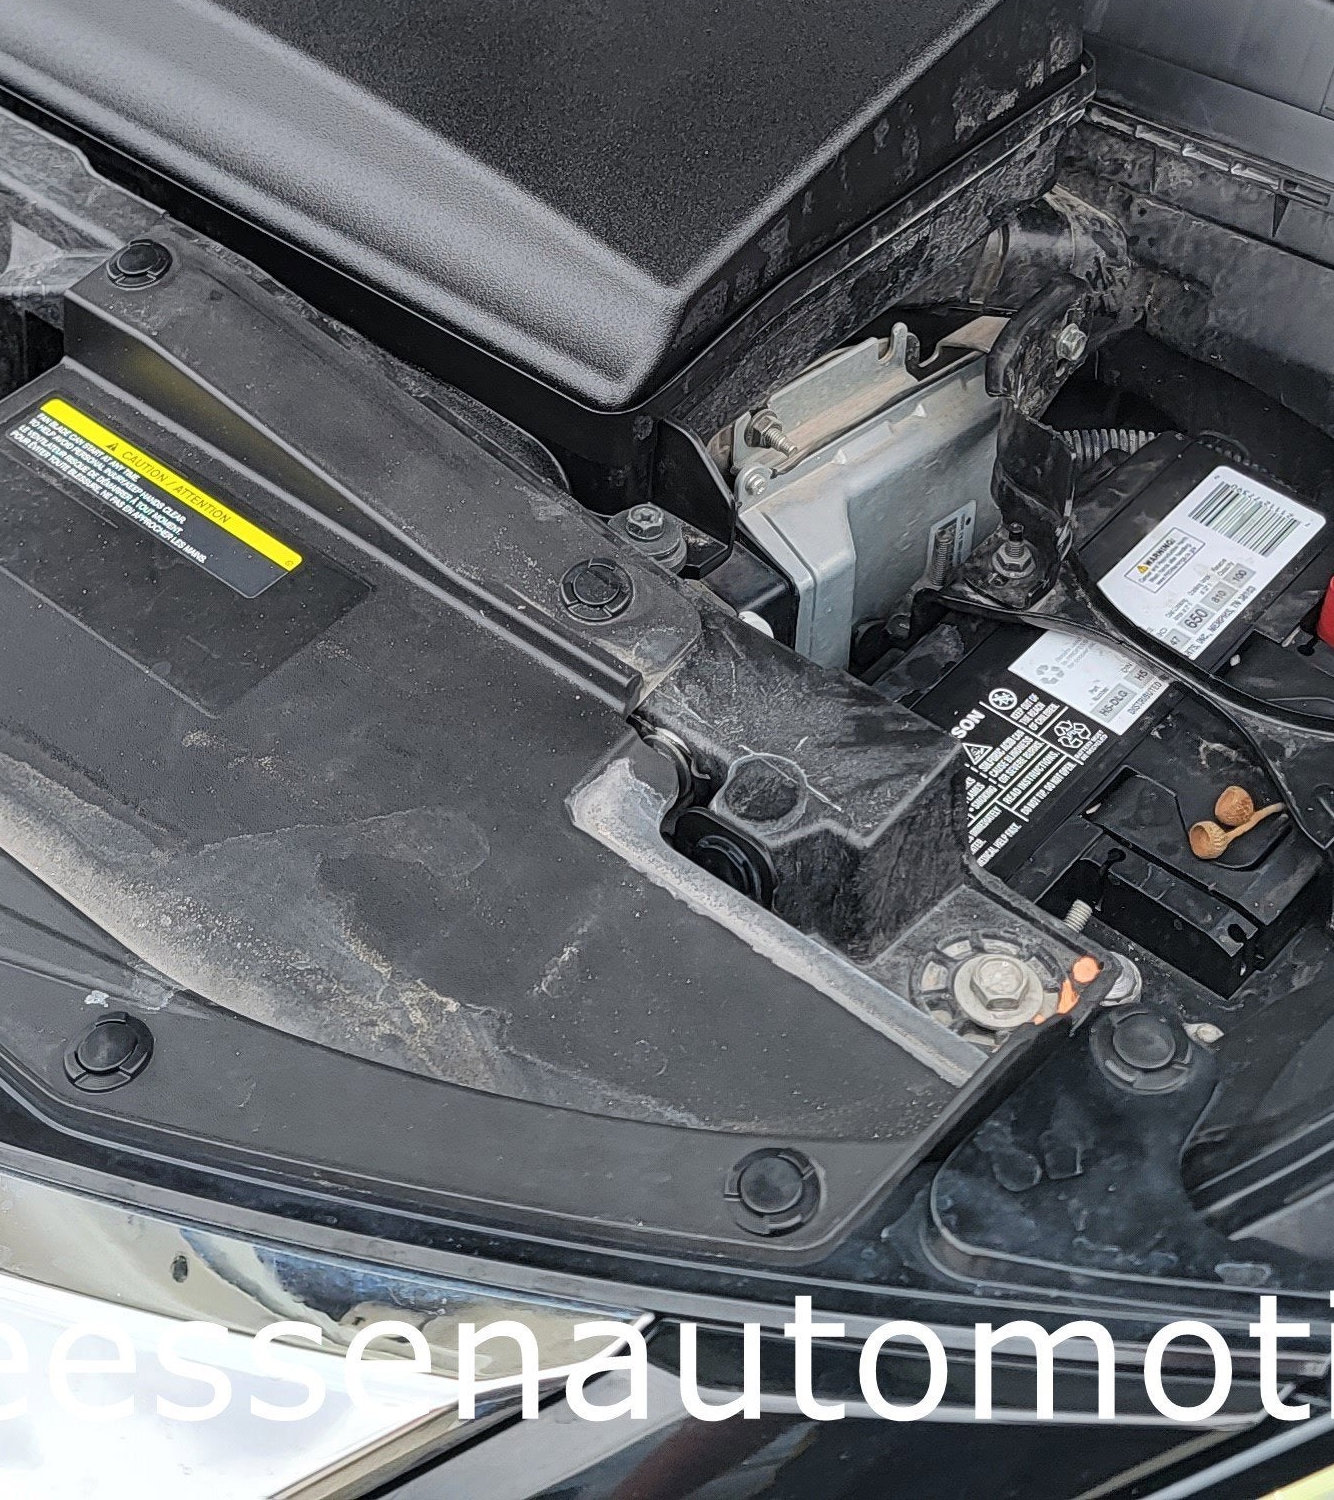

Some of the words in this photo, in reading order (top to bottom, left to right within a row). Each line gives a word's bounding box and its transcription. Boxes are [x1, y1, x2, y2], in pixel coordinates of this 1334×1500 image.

[36, 412, 52, 424] FAN
[48, 420, 71, 437] BLADE
[68, 432, 85, 446] CAN
[82, 442, 104, 458] START
[100, 454, 112, 463] AT
[107, 459, 125, 472] ANY
[18, 424, 30, 434] LE
[26, 429, 67, 458] VENTILATEUR
[65, 455, 89, 473] RISQUE
[87, 469, 99, 479] DE
[135, 502, 154, 516] TOUT
[28, 418, 41, 428] TO
[37, 424, 56, 437] HELP
[52, 435, 74, 450] AVOID
[71, 446, 105, 471] PERSONAL
[140, 492, 165, 510] HANDS
[9, 429, 30, 445] POUR
[48, 454, 70, 471] TOUTE
[100, 489, 112, 499] NE
[109, 496, 124, 508] PAS
[122, 504, 135, 514] EN
[170, 536, 186, 549] LES
[121, 450, 168, 482] CAUTION
[173, 486, 231, 524] ATTENTION
[1143, 537, 1175, 565] WARNING:
[1232, 568, 1247, 581] 100
[1211, 589, 1226, 603] 810
[1183, 607, 1209, 630] 650
[1134, 669, 1148, 680] H5
[1019, 698, 1033, 709] OUT
[1027, 692, 1039, 702] OF
[1098, 690, 1128, 716] H5-DLG
[1028, 721, 1038, 730] OF
[1002, 786, 1022, 804] READ
[1020, 804, 1032, 815] DO
[1026, 795, 1041, 808] NOT
[1049, 772, 1064, 785] NOT
[992, 833, 1009, 848] HELP
